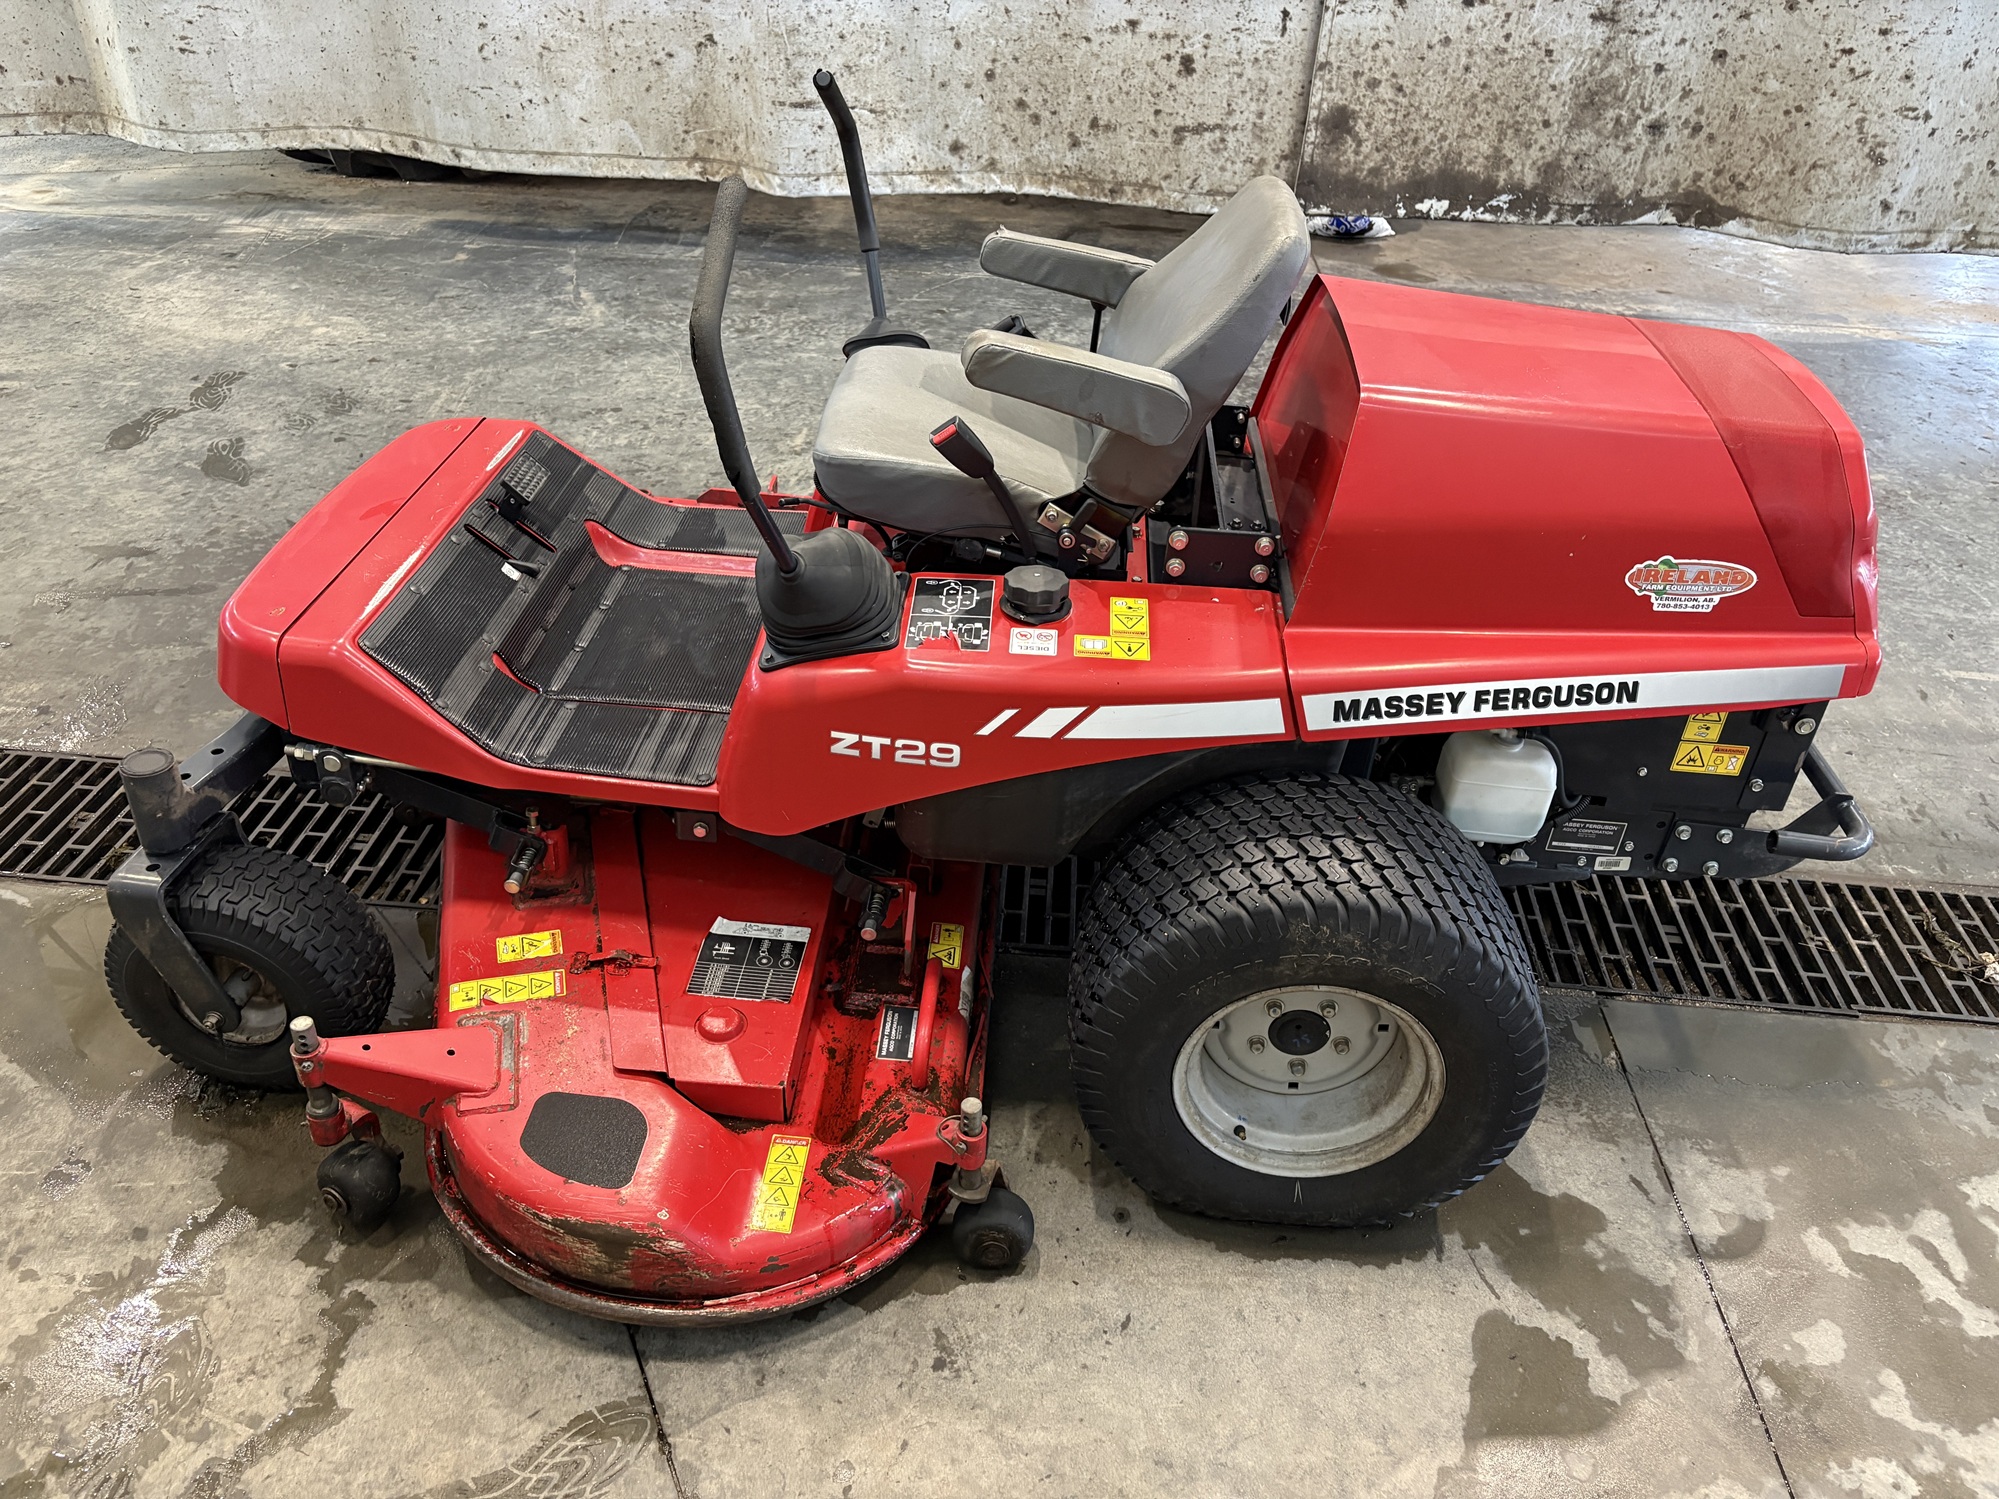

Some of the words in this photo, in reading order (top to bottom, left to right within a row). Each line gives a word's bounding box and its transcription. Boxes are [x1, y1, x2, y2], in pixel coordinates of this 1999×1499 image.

[1633, 567, 1749, 585] IRELAND
[1666, 584, 1715, 592] EQUIPMENT
[1333, 691, 1466, 722] MASSEY
[1473, 680, 1640, 712] FERGUSON
[830, 730, 961, 768] ZT29
